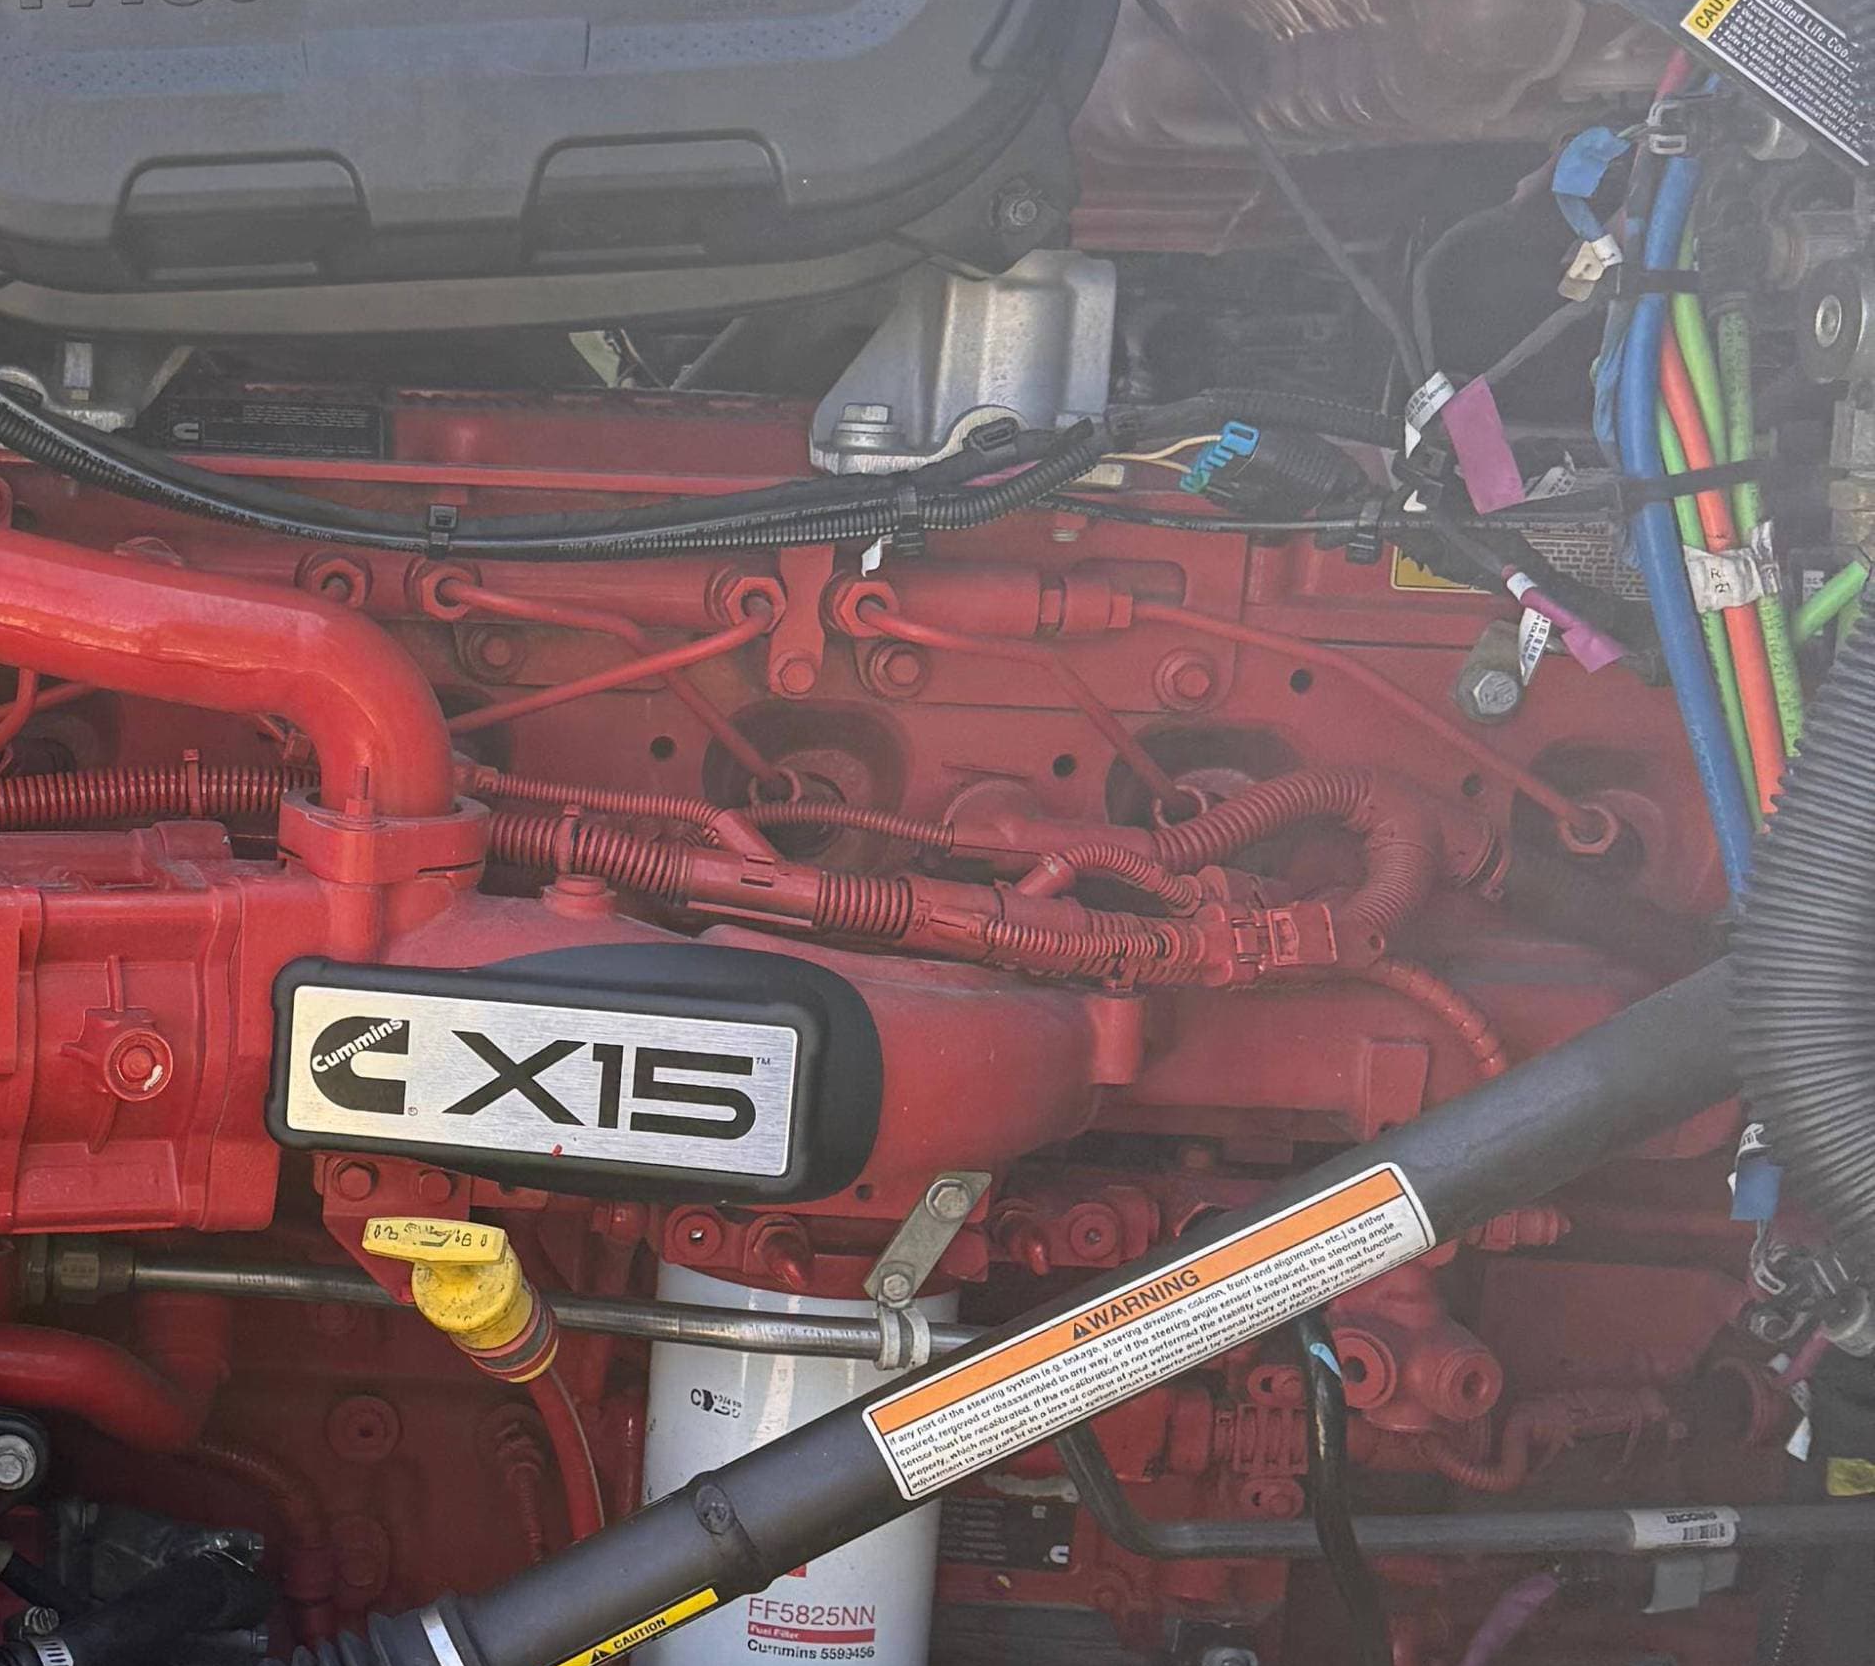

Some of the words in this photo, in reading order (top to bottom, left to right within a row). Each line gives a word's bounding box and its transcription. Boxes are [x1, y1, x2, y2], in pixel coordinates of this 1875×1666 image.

[1805, 14, 1826, 41] Life
[311, 1017, 403, 1073] Cummins
[443, 1029, 755, 1140] X15
[980, 1409, 991, 1418] or
[1057, 1373, 1069, 1382] in
[1069, 1365, 1086, 1377] any
[1112, 1348, 1122, 1357] or
[1123, 1343, 1131, 1351] if
[1132, 1337, 1149, 1348] the
[1150, 1319, 1190, 1340] steering
[1191, 1306, 1218, 1322] angle
[1219, 1289, 1251, 1308] sensor
[1252, 1284, 1263, 1293] is
[1308, 1255, 1326, 1266] the
[1327, 1236, 1367, 1258] steering
[1368, 1222, 1394, 1239] angle
[1086, 1269, 1199, 1329] WARNING
[888, 1436, 896, 1445] If
[898, 1429, 914, 1442] any
[916, 1419, 937, 1435] part
[936, 1412, 947, 1424] of
[948, 1407, 964, 1418] the
[966, 1389, 1005, 1410] steering
[1005, 1372, 1040, 1392] system
[1102, 1326, 1142, 1348] steering
[1347, 1226, 1357, 1234] is
[1357, 1212, 1385, 1229] either
[613, 1615, 668, 1649] CAUTION
[748, 1596, 875, 1627] FF5825NN
[747, 1638, 817, 1660] Cummins
